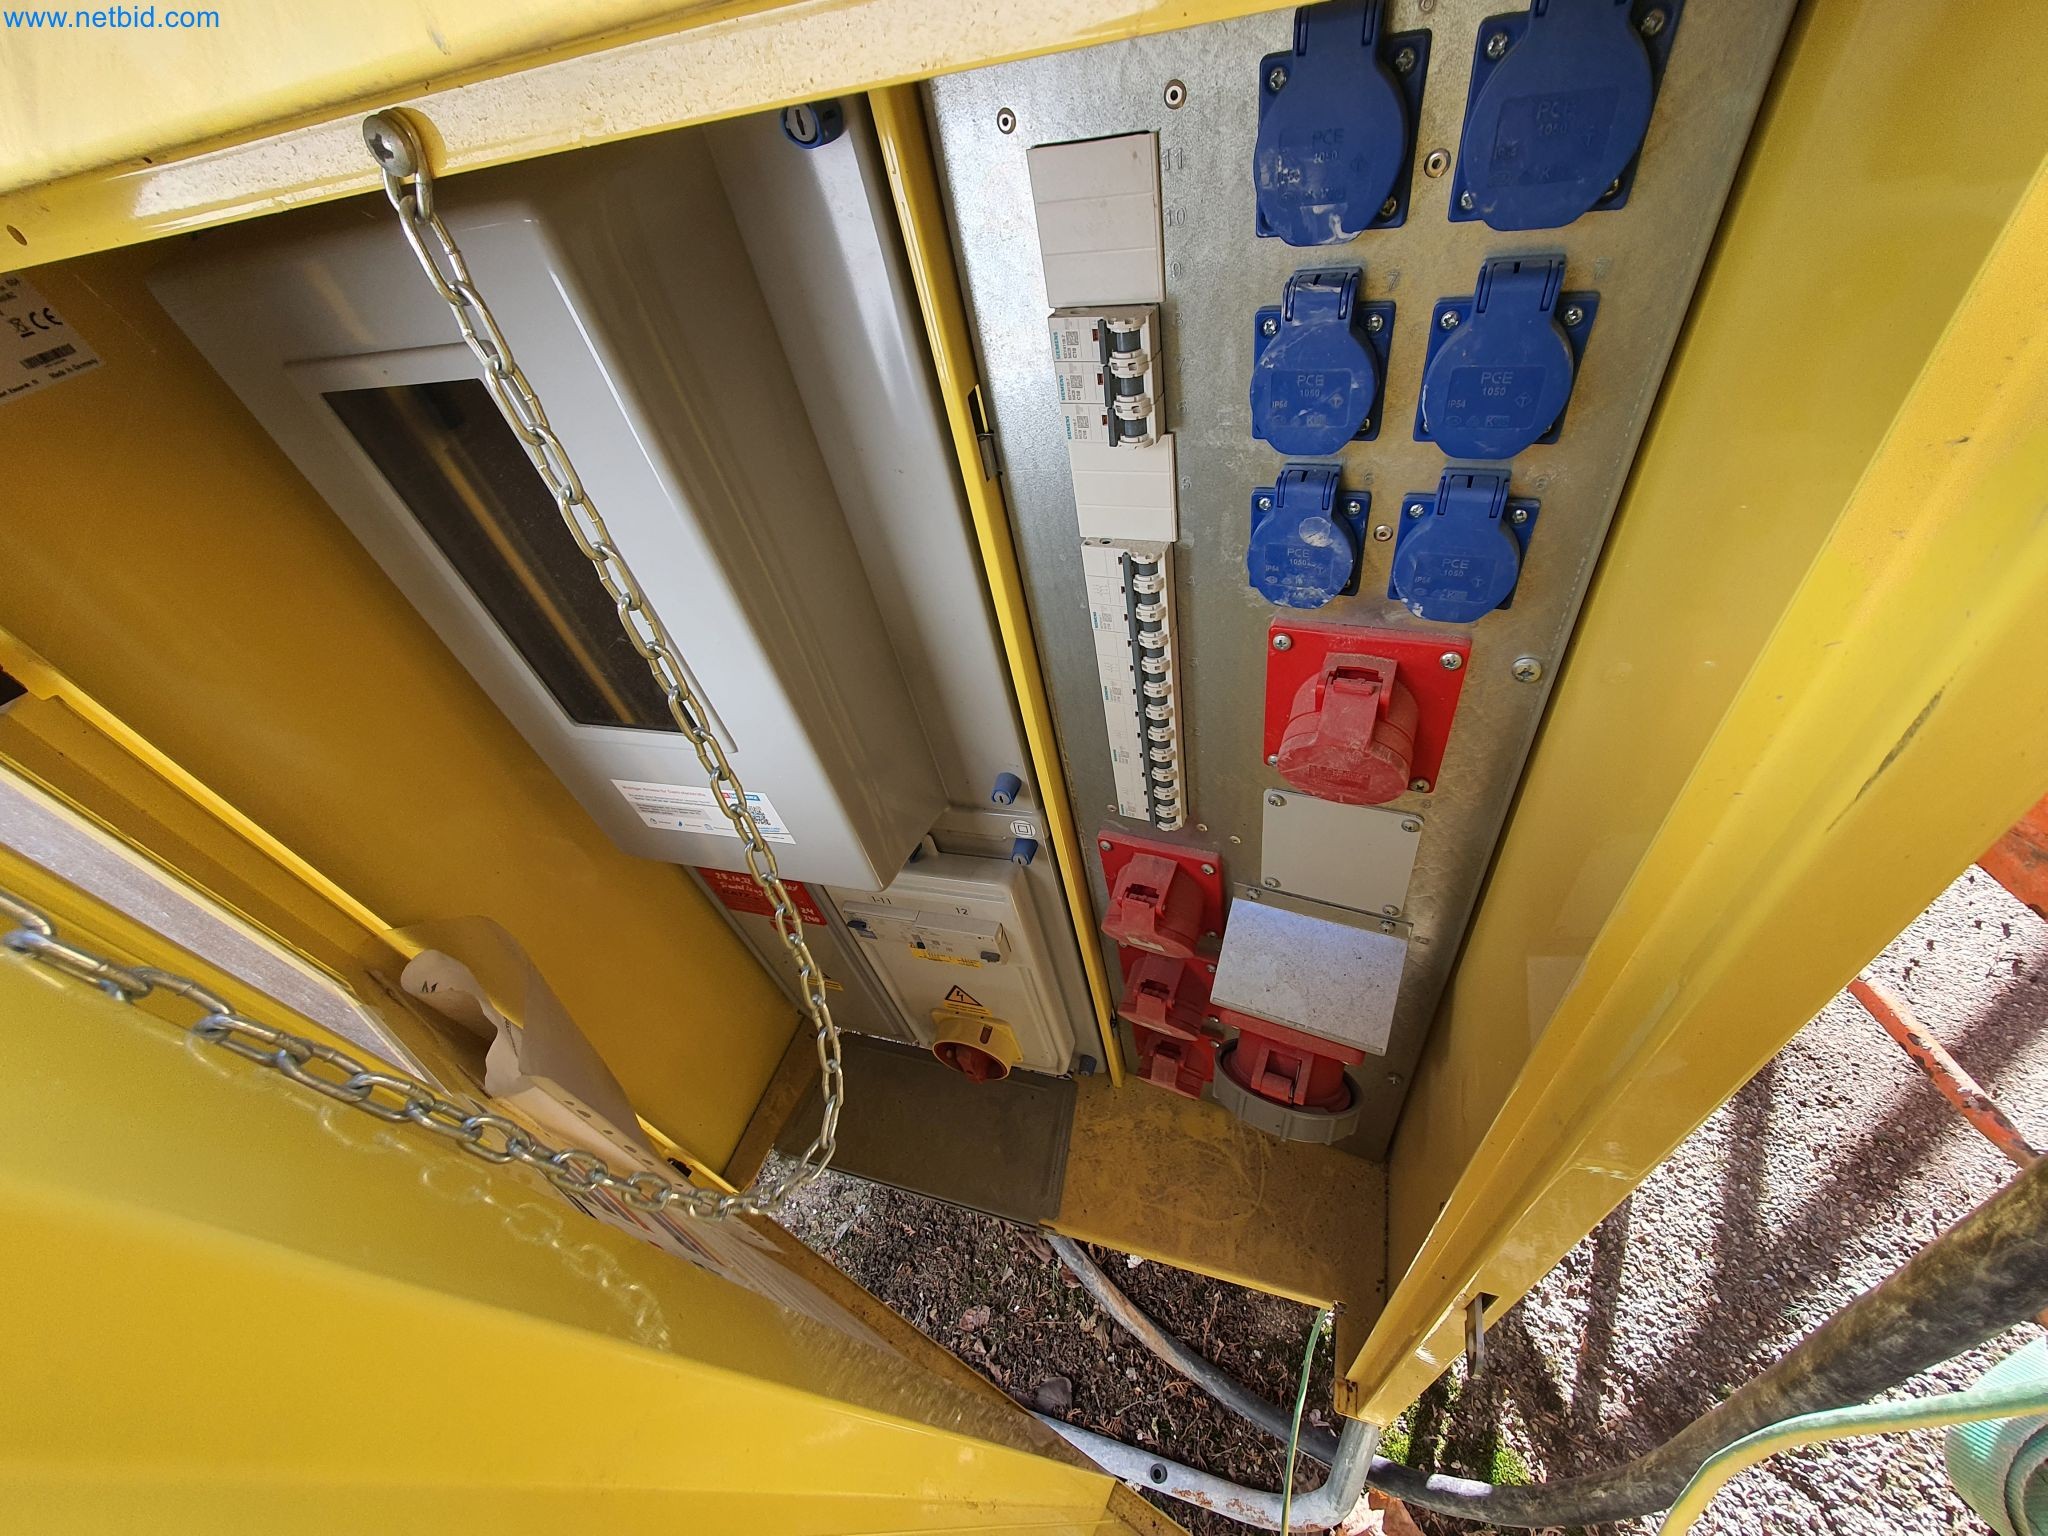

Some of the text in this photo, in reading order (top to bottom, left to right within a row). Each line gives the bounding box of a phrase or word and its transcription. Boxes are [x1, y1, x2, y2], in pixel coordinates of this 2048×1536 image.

[1162, 148, 1184, 171] 11
[1166, 207, 1187, 227] 10
[1388, 271, 1399, 291] 7
[1297, 374, 1325, 387] PCE
[1481, 371, 1514, 384] PCE
[1300, 389, 1320, 397] 1050
[1483, 387, 1506, 396] 1050
[1448, 399, 1466, 408] IP54
[1287, 548, 1310, 558] PCE
[1441, 558, 1470, 569] PCE
[1444, 569, 1464, 577] 1050
[955, 907, 969, 916] 12
